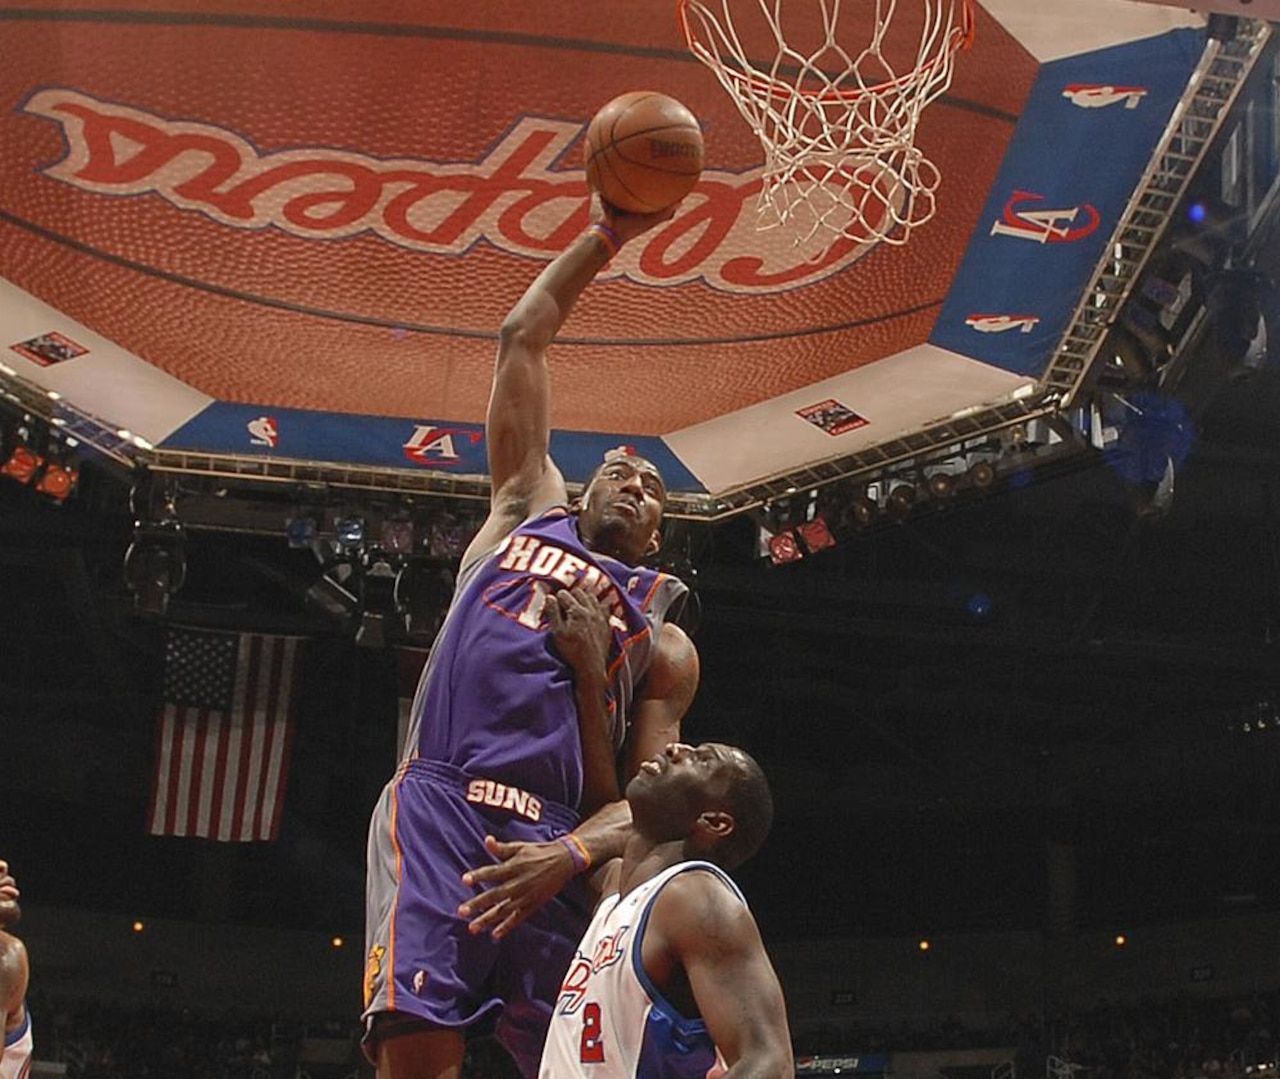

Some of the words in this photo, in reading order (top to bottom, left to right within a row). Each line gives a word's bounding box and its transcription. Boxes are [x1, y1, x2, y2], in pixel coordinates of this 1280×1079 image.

[18, 86, 908, 294] Clppers
[467, 779, 542, 822] SUNS
[580, 1002, 605, 1063] 2
[811, 1058, 859, 1071] PEPSI
